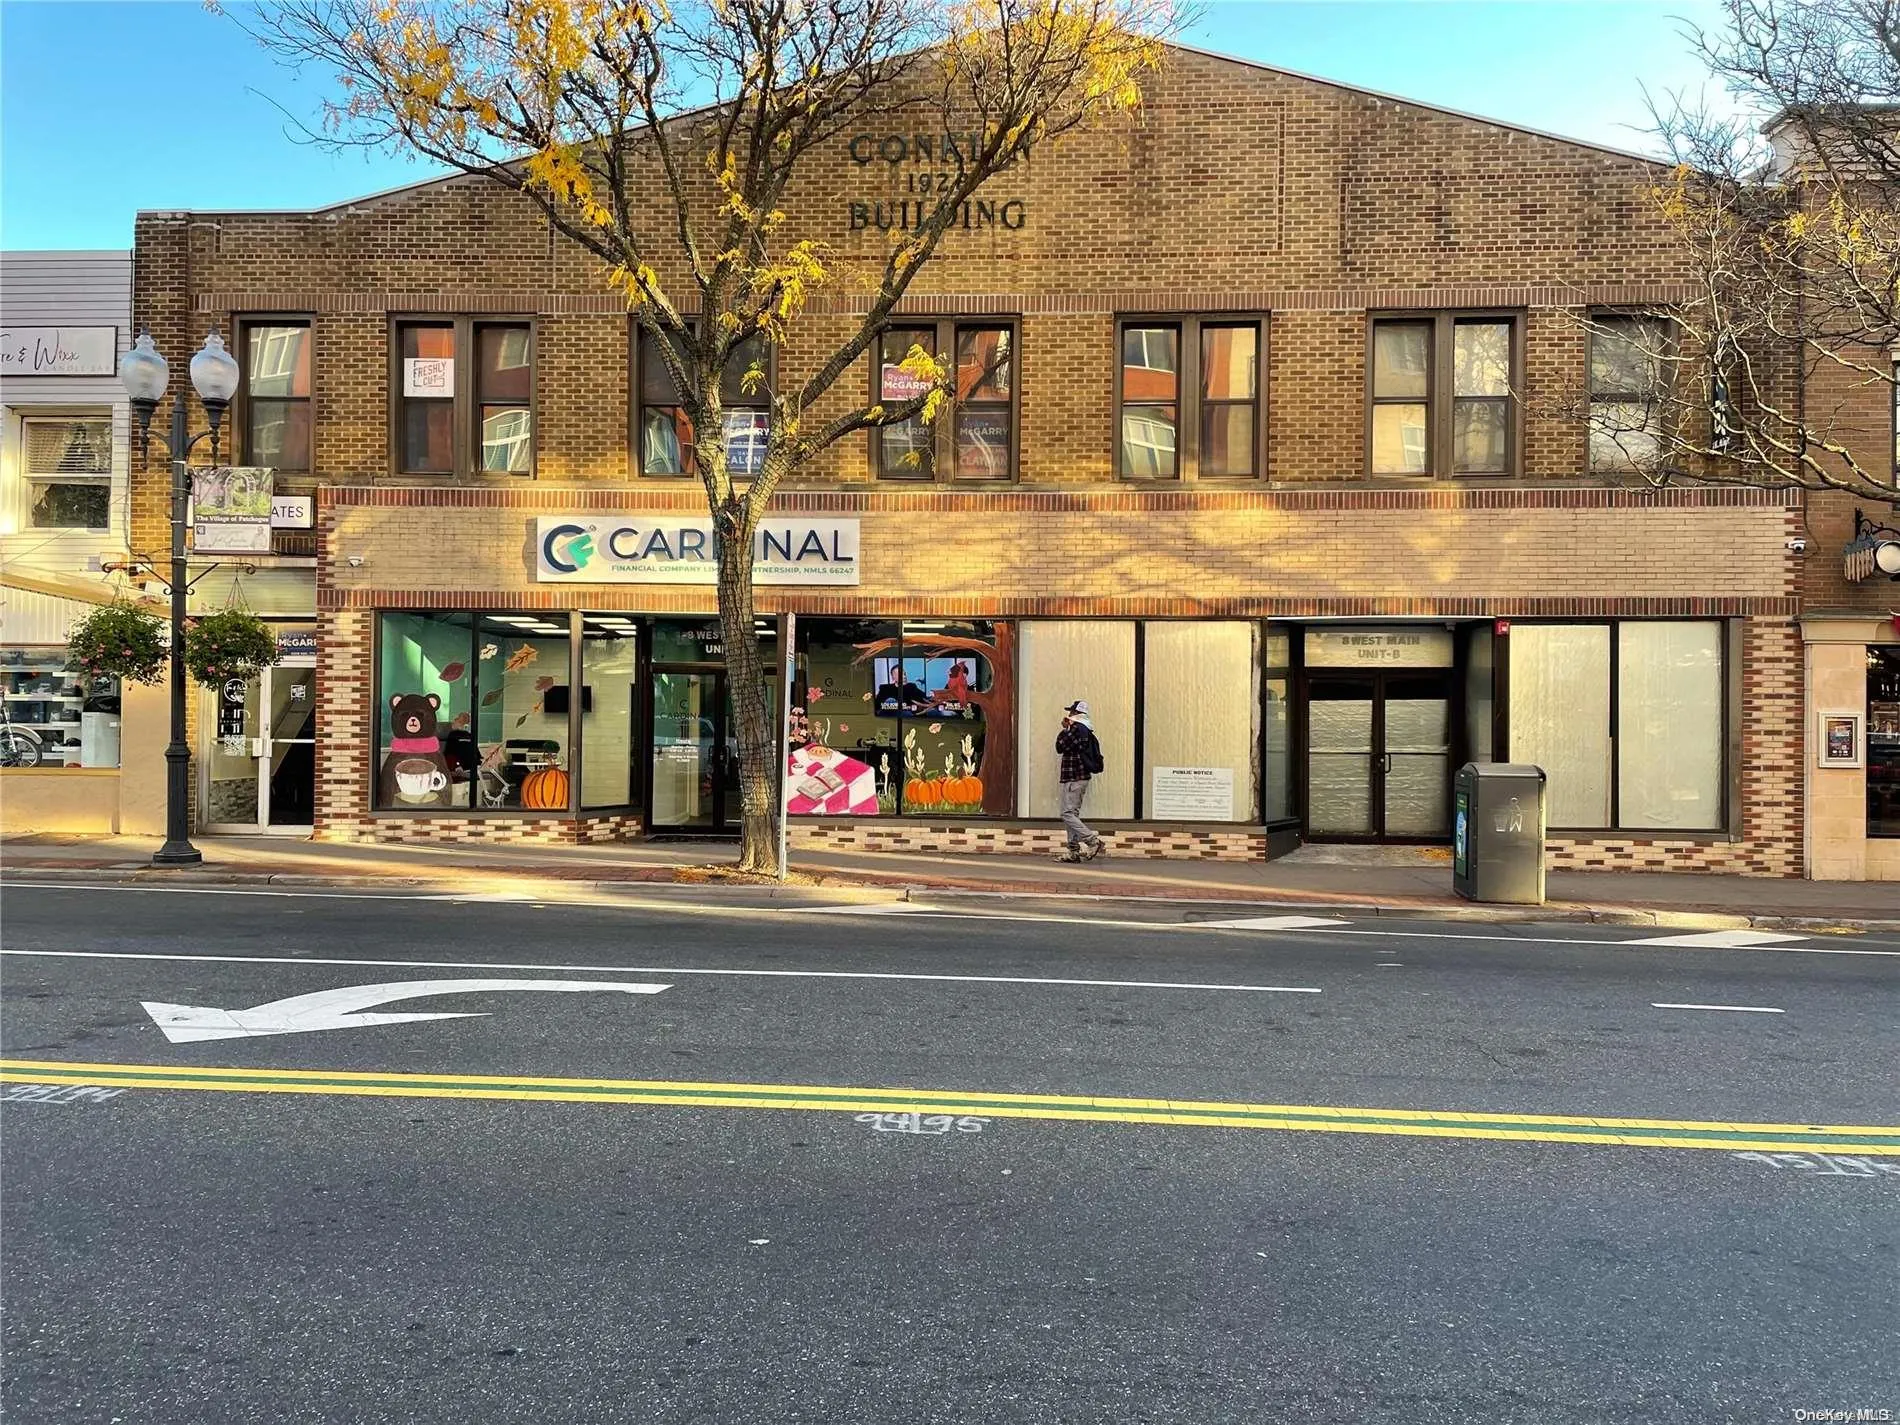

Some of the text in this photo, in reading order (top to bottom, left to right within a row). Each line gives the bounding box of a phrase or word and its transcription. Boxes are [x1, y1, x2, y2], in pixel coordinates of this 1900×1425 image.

[850, 134, 1031, 164] CONKLN
[413, 361, 447, 380] FRESHLY
[422, 374, 439, 386] CUT
[887, 373, 909, 383] Ryan
[884, 380, 933, 391] McGARRY
[960, 427, 1009, 436] McGARRY
[609, 527, 853, 561] CARNAL
[659, 565, 701, 573] COMPANY
[1342, 636, 1420, 646] 8 WEST MAIN
